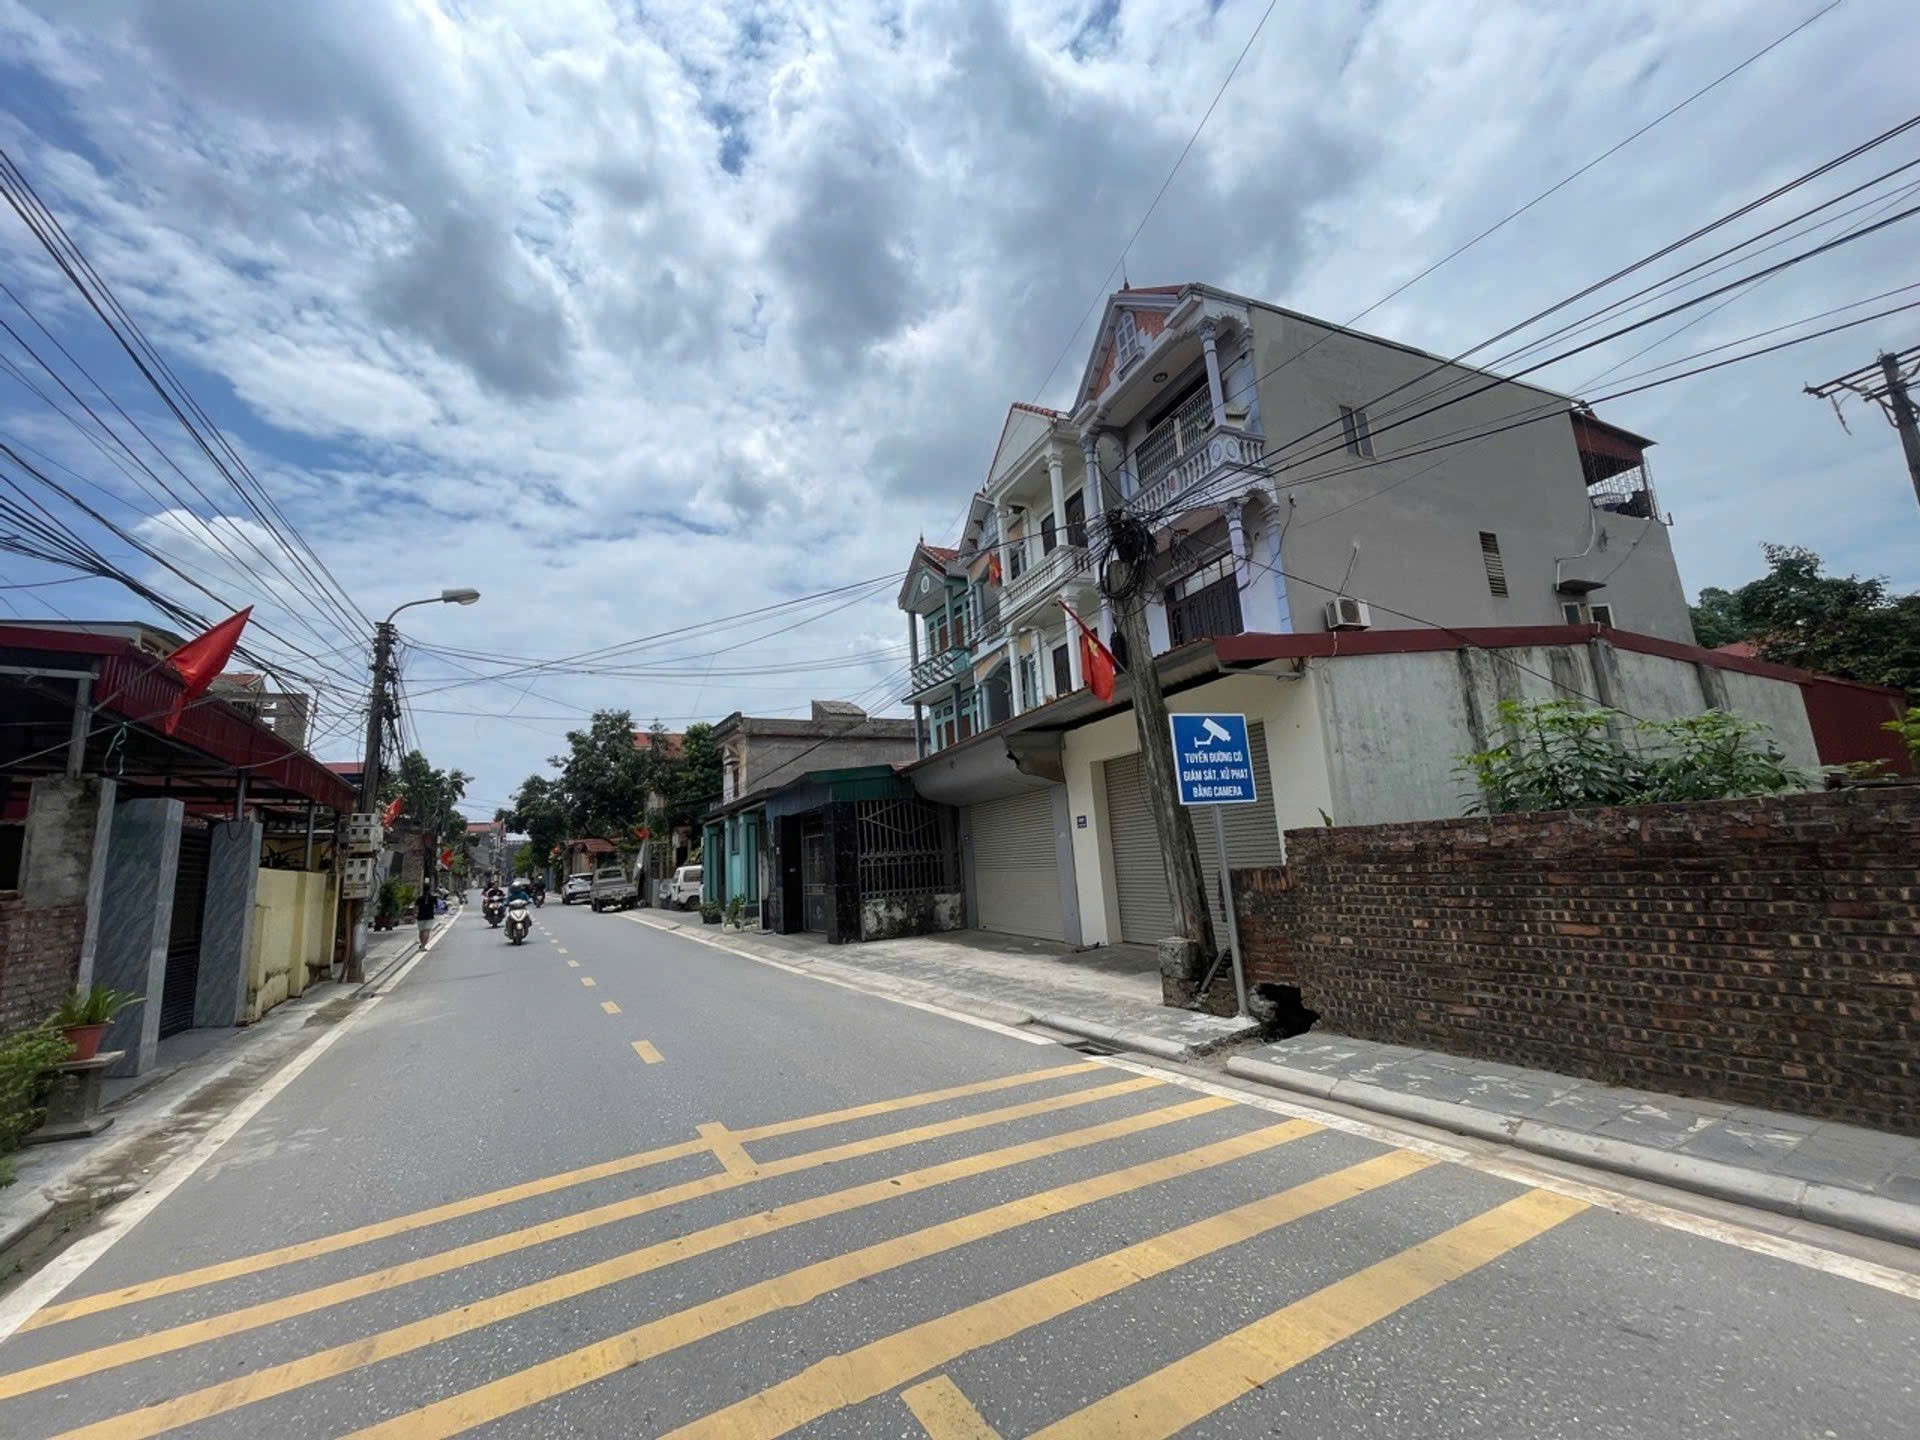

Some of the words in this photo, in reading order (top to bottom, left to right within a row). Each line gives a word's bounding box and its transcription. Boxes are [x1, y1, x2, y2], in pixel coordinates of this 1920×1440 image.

[1233, 750, 1243, 762] CÓ
[1183, 770, 1202, 781] GIÁM
[1213, 785, 1243, 796] CAMERA
